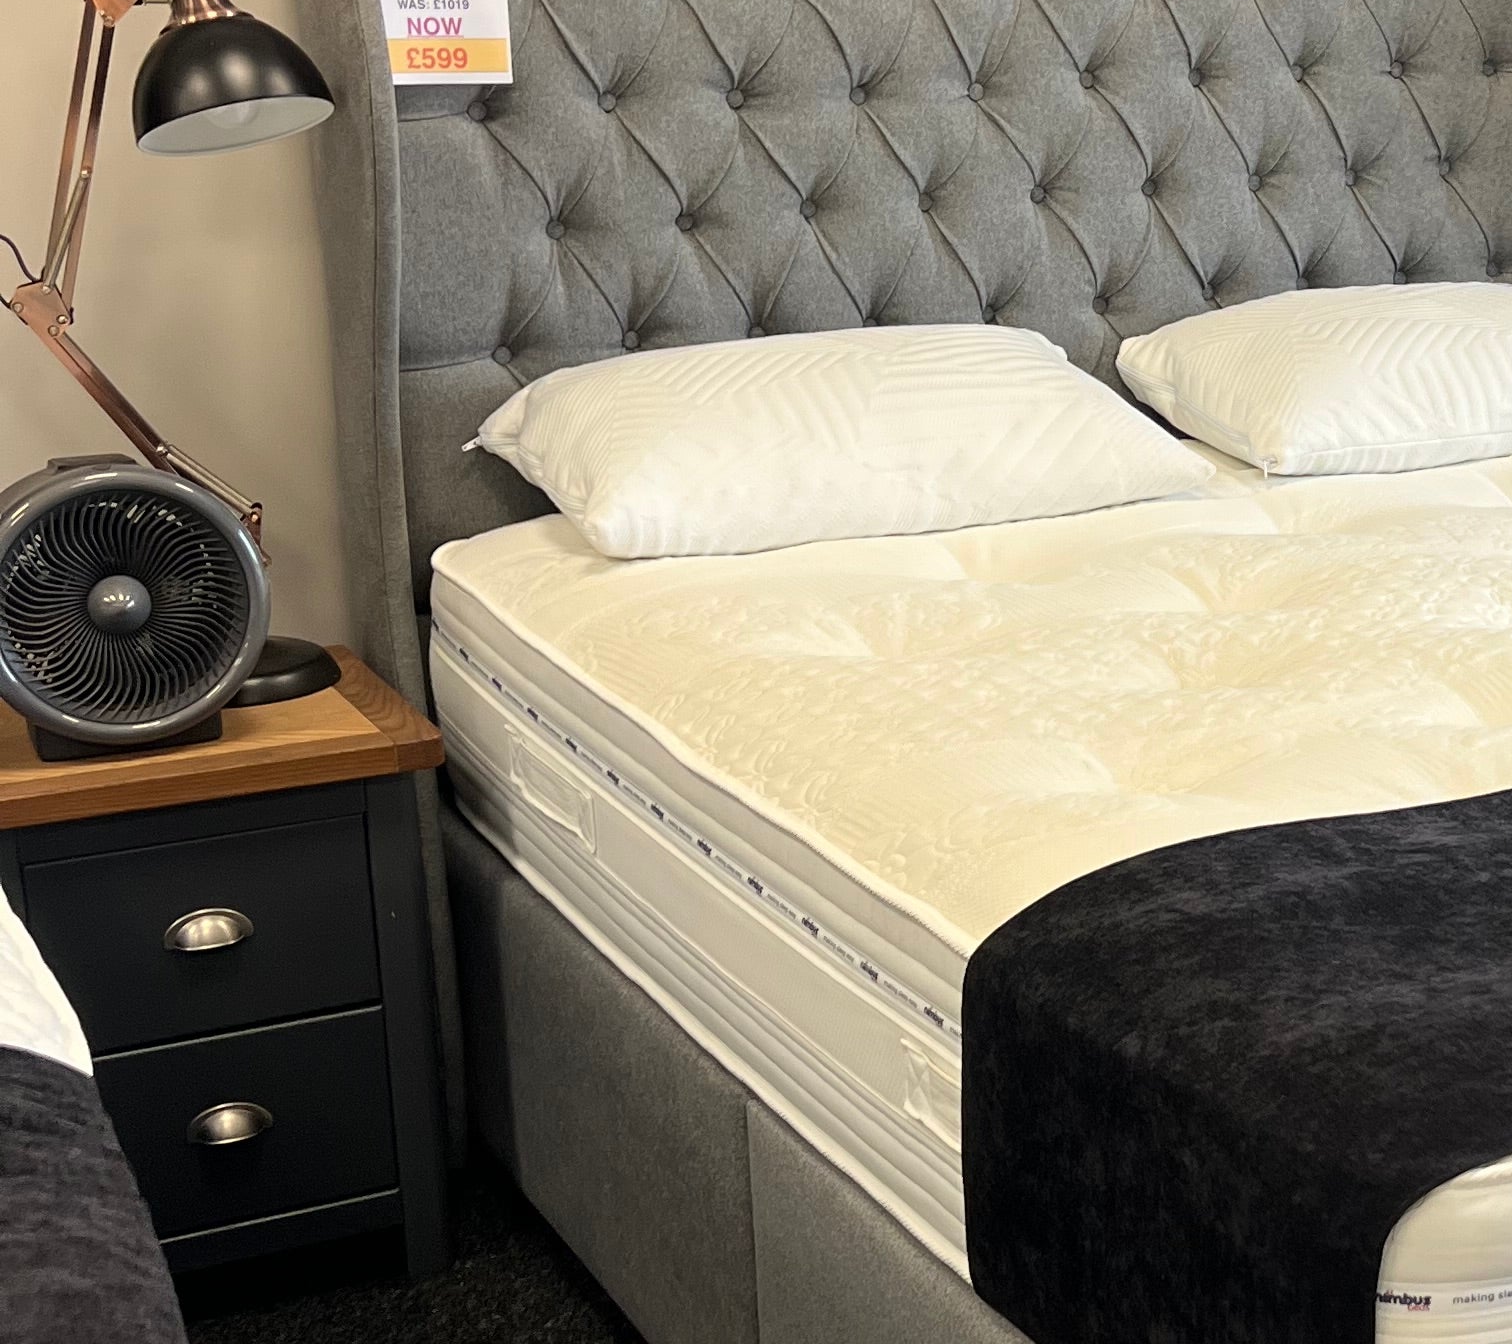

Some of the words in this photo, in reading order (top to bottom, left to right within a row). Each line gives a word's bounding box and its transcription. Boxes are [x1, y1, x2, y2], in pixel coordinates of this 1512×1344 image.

[397, 0, 430, 10] WAS:
[433, 0, 469, 10] £1019
[407, 17, 463, 36] NOW
[406, 47, 468, 69] £599
[1452, 1291, 1495, 1305] making
